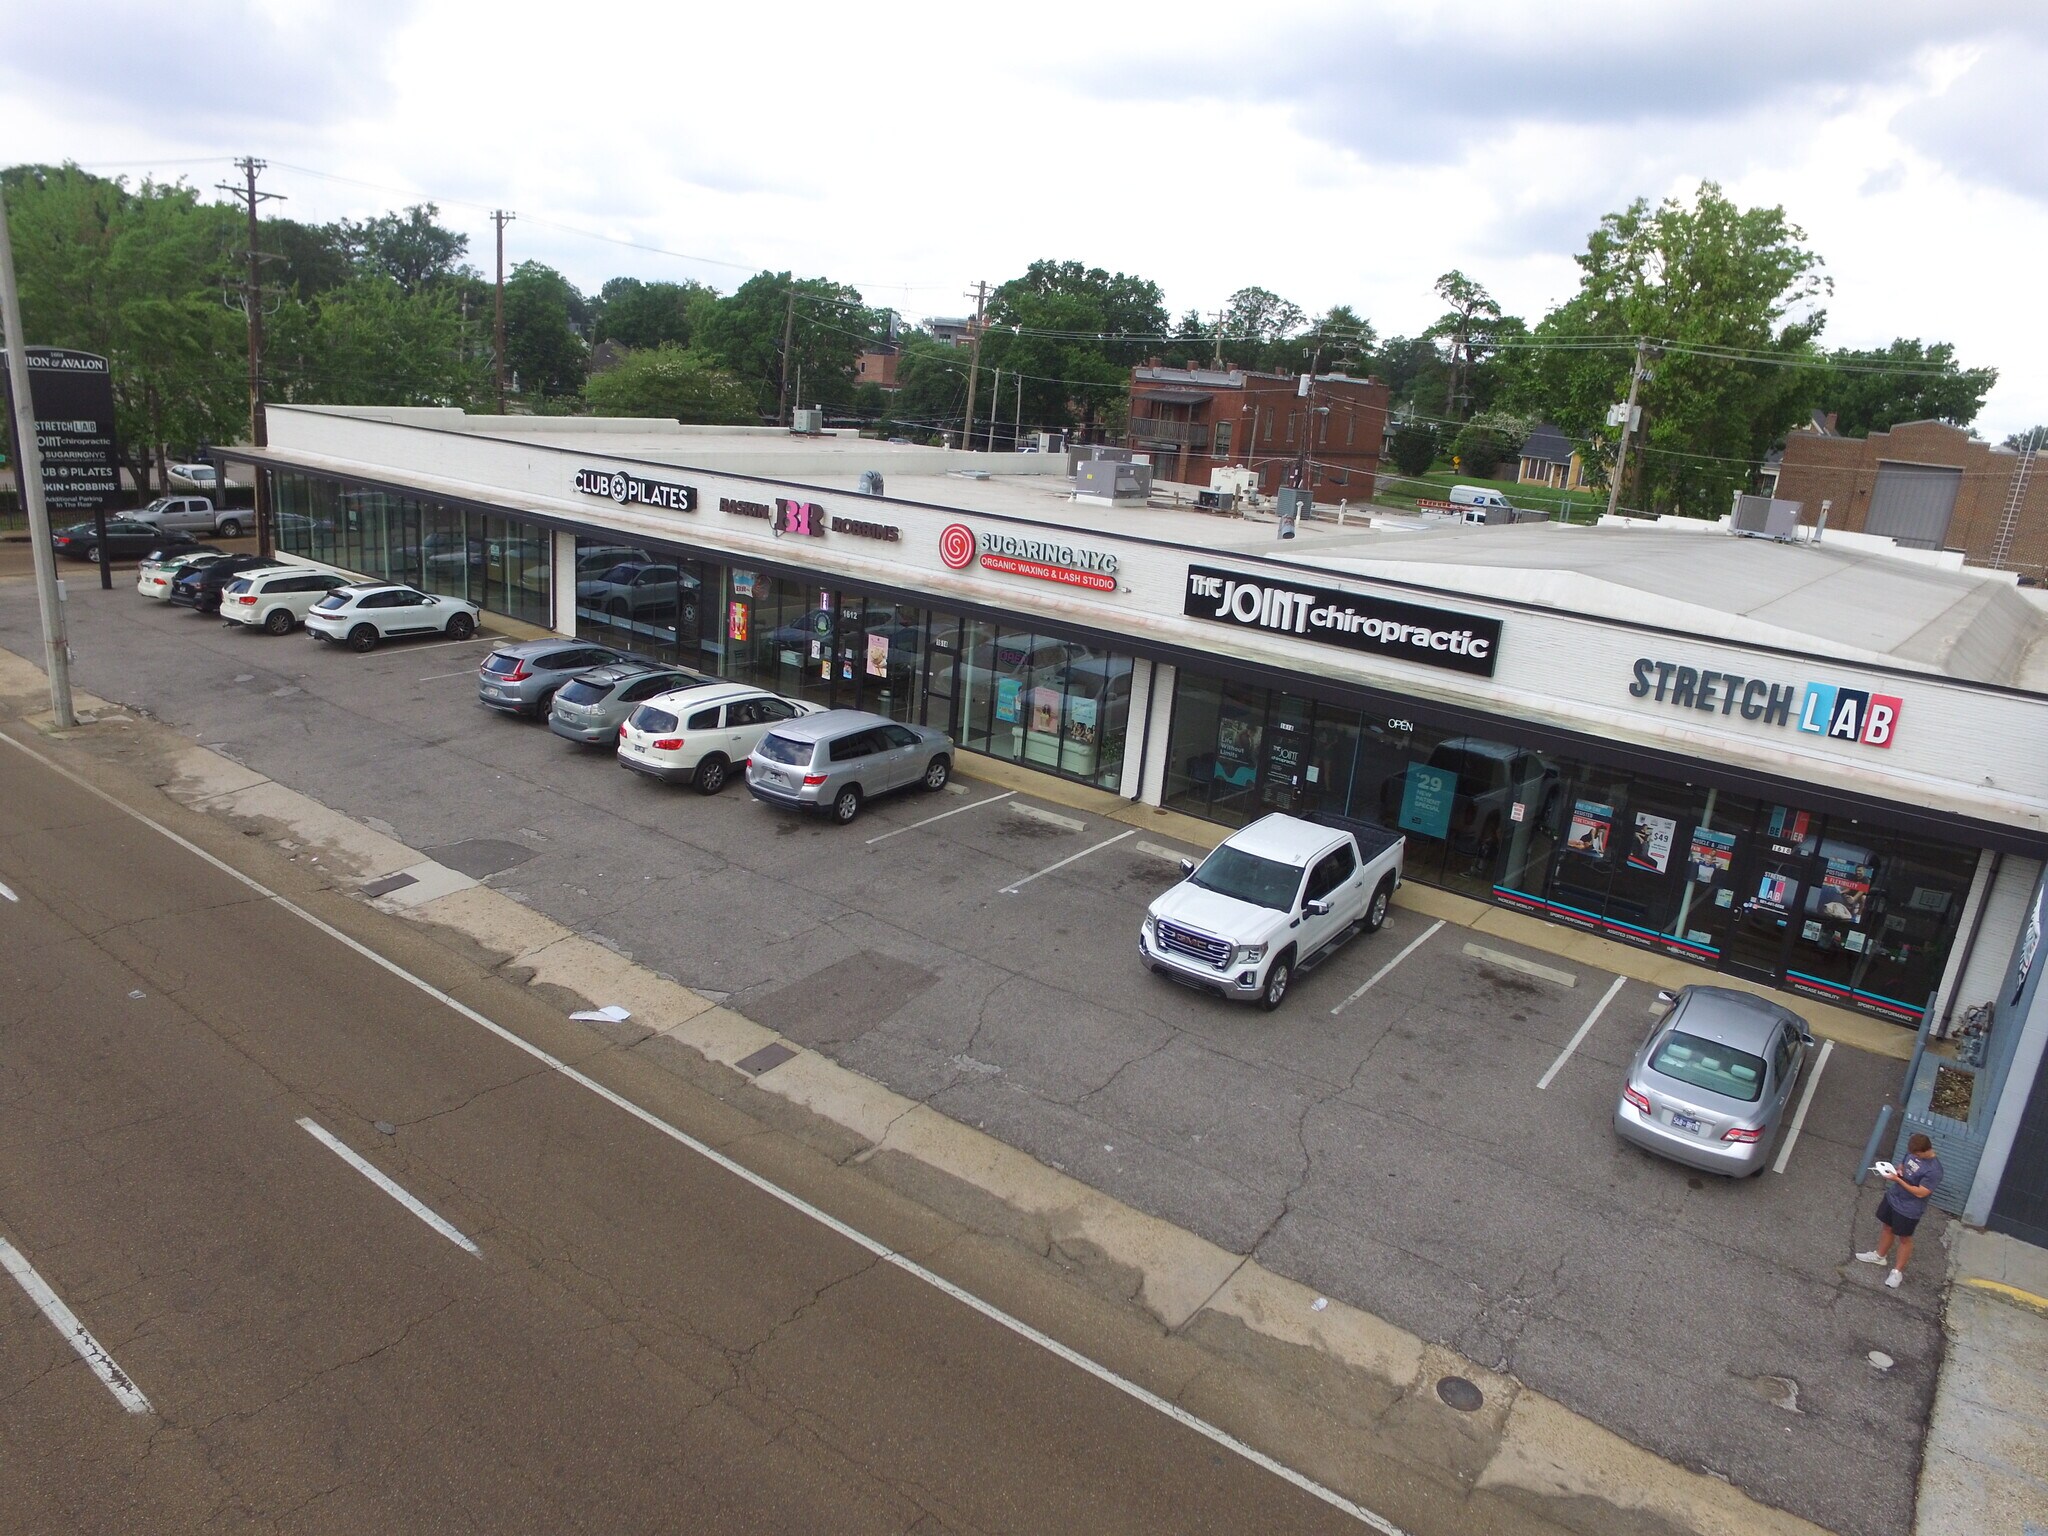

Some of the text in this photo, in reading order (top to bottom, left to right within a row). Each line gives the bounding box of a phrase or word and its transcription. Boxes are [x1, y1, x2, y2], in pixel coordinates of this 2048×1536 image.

[26, 357, 49, 367] ION
[61, 359, 103, 370] AVALON
[37, 436, 61, 446] OINT
[42, 468, 112, 476] UB PILATES
[574, 472, 687, 510] CLUB PILATES
[720, 498, 770, 519] BASKIN
[832, 516, 900, 542] ROBBINS
[980, 533, 1117, 573] SUGARING NYC
[981, 557, 1016, 571] ORGANIC
[1018, 564, 1049, 577] WAXING
[1059, 571, 1080, 583] LASH
[1083, 577, 1114, 589] STUDIO
[843, 610, 857, 619] 1612
[1190, 574, 1490, 659] THE JOINT chiropractic
[1628, 658, 1895, 745] STRETCH LAB
[1388, 718, 1413, 732] OPEN
[1221, 736, 1232, 744] Life
[1220, 749, 1238, 758] Limits
[1221, 743, 1244, 753] Without
[1414, 801, 1439, 813] SPECIAL
[1415, 796, 1440, 807] PATIENT
[1654, 832, 1669, 842] $49
[1773, 845, 1791, 854] 1618
[1764, 871, 1786, 882] STRETCH
[1826, 869, 1847, 878] POSTURE
[1830, 877, 1858, 888] FLEXIBILITY
[1498, 897, 1534, 911] INCREASE MOBILITY
[1565, 916, 1594, 928] PERFORMANCE
[1176, 933, 1207, 949] GMC
[1607, 928, 1650, 945] ASSISTED STRETCHING
[1688, 952, 1706, 962] POSTURE
[1795, 984, 1840, 1000] INCREASE MOBILITY
[1857, 1001, 1913, 1022] SPORTS PERFORMANCE
